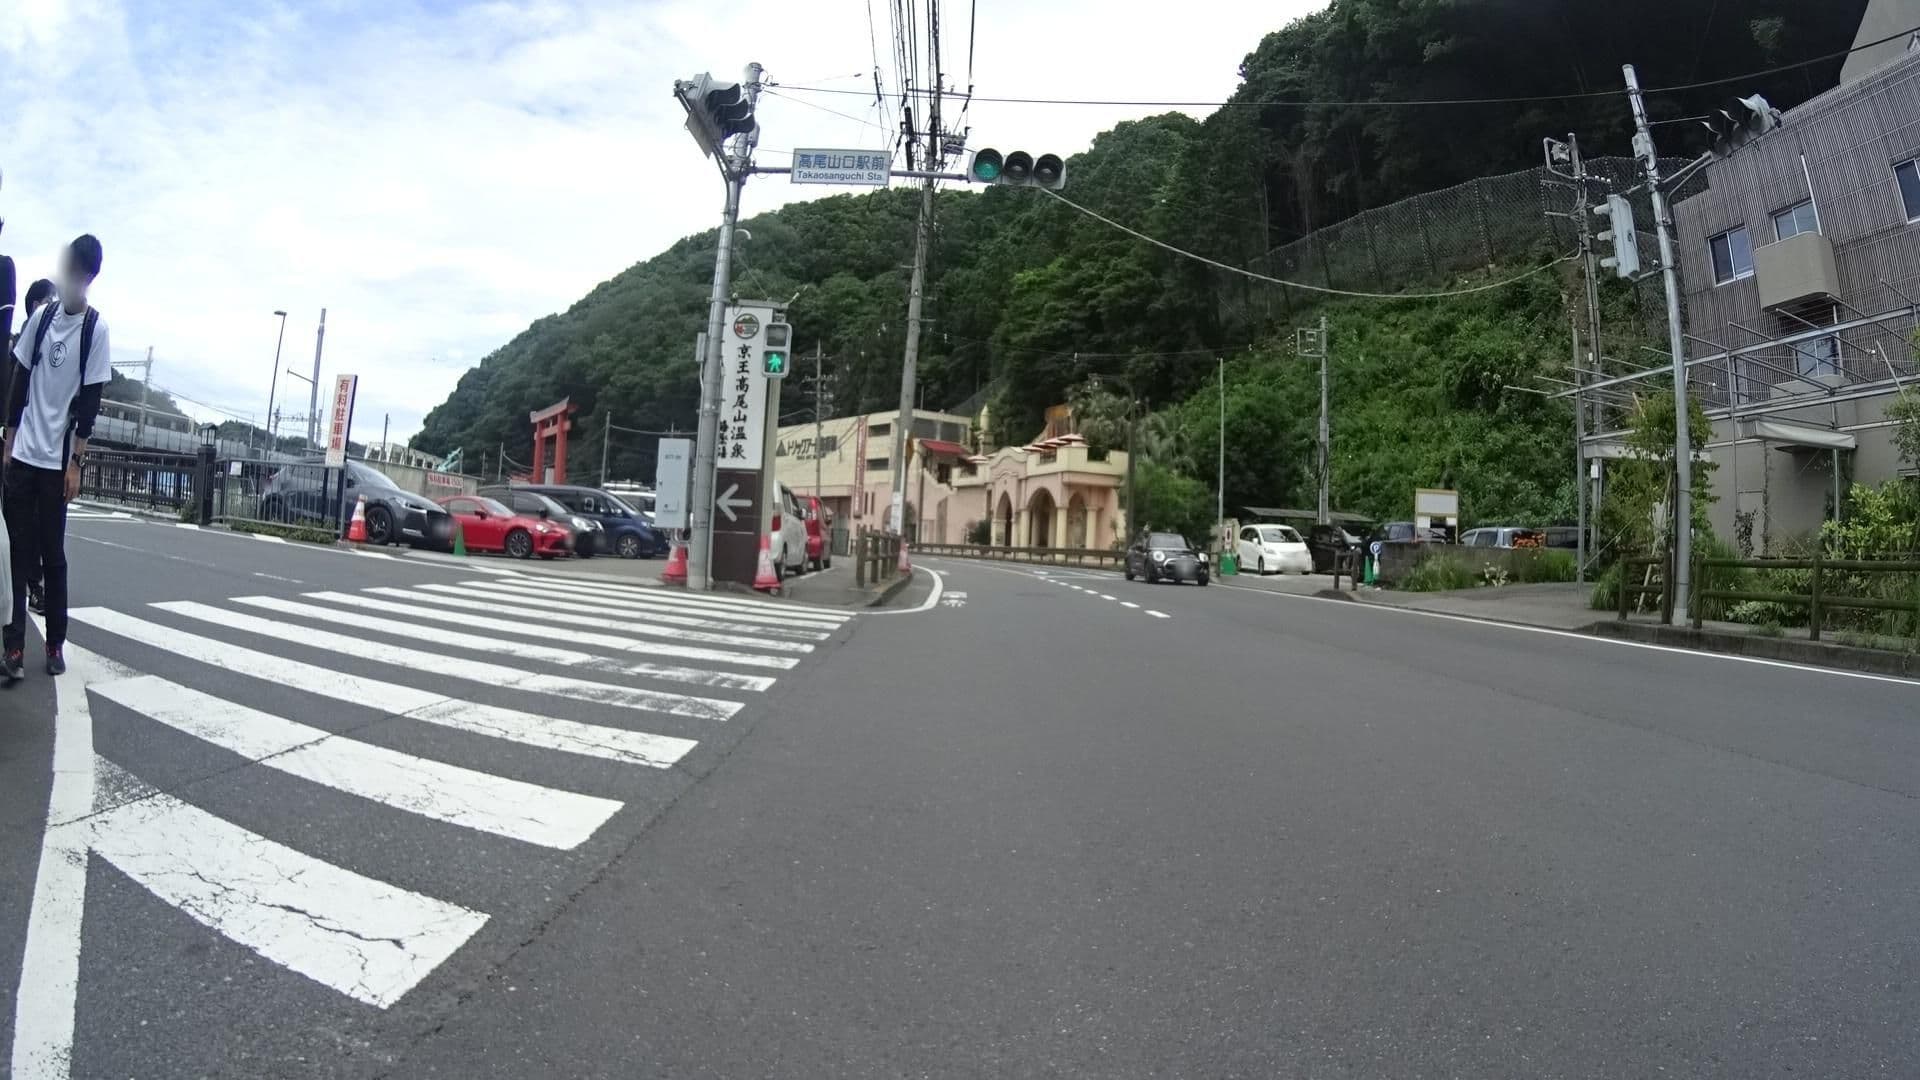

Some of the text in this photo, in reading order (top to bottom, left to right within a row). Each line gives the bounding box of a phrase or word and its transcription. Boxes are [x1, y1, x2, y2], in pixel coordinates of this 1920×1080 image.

[799, 154, 885, 170] 高尾山口駅前
[797, 170, 864, 181] Takaosanguchi
[731, 343, 752, 459] 京王高尾山温泉
